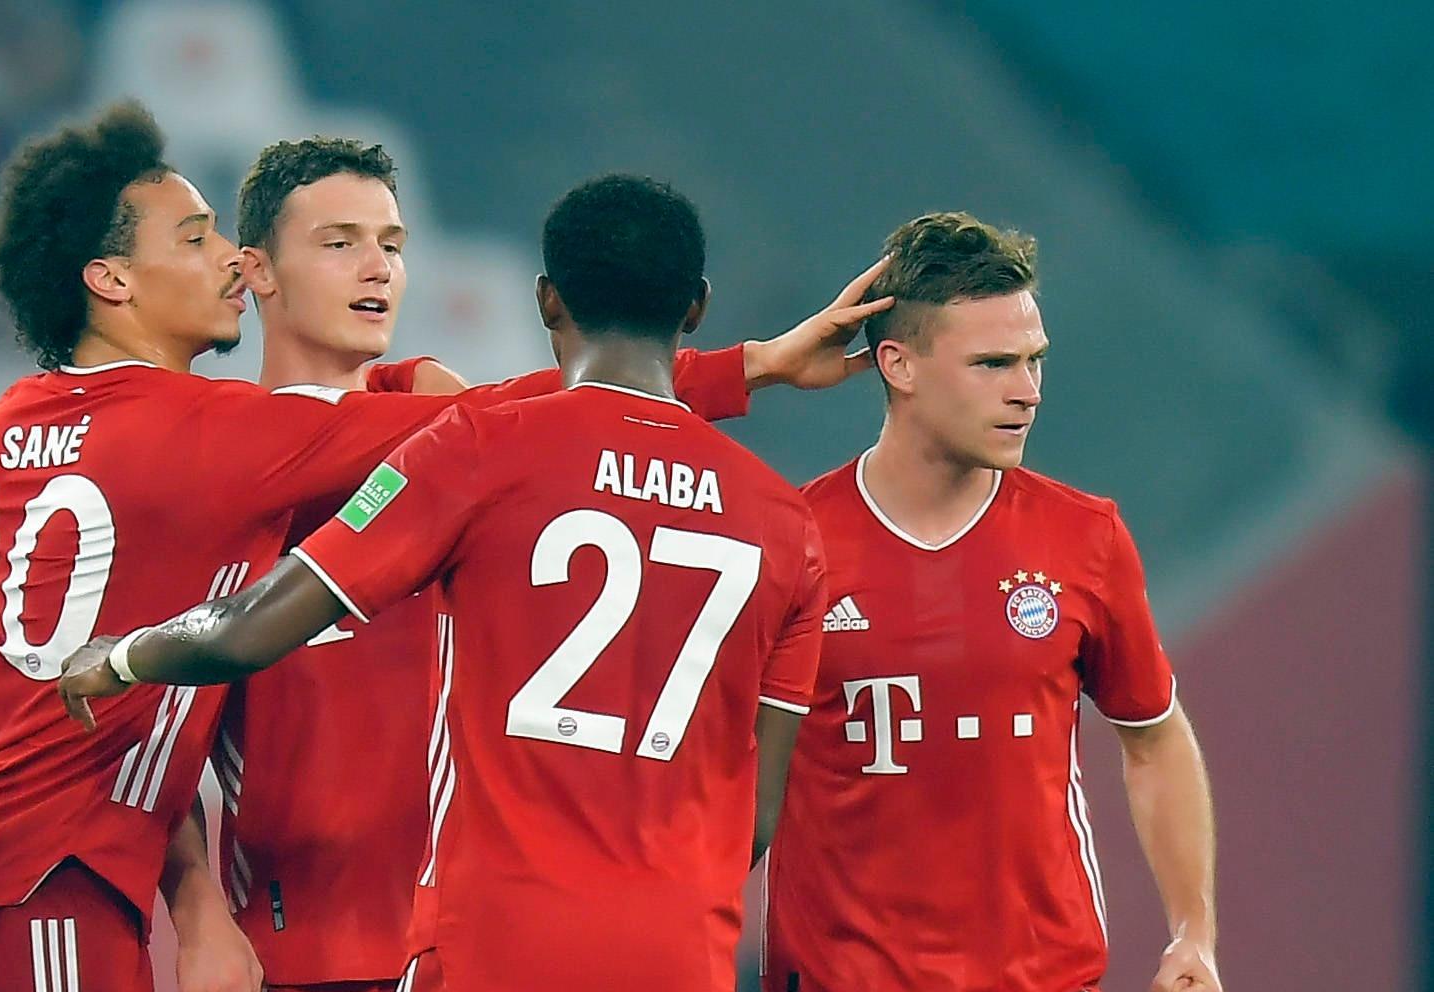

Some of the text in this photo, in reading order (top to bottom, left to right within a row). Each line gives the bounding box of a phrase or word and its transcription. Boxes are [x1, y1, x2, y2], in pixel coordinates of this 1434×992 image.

[0, 415, 92, 470] SANÉ
[594, 449, 723, 514] ALABA
[505, 508, 763, 762] 27
